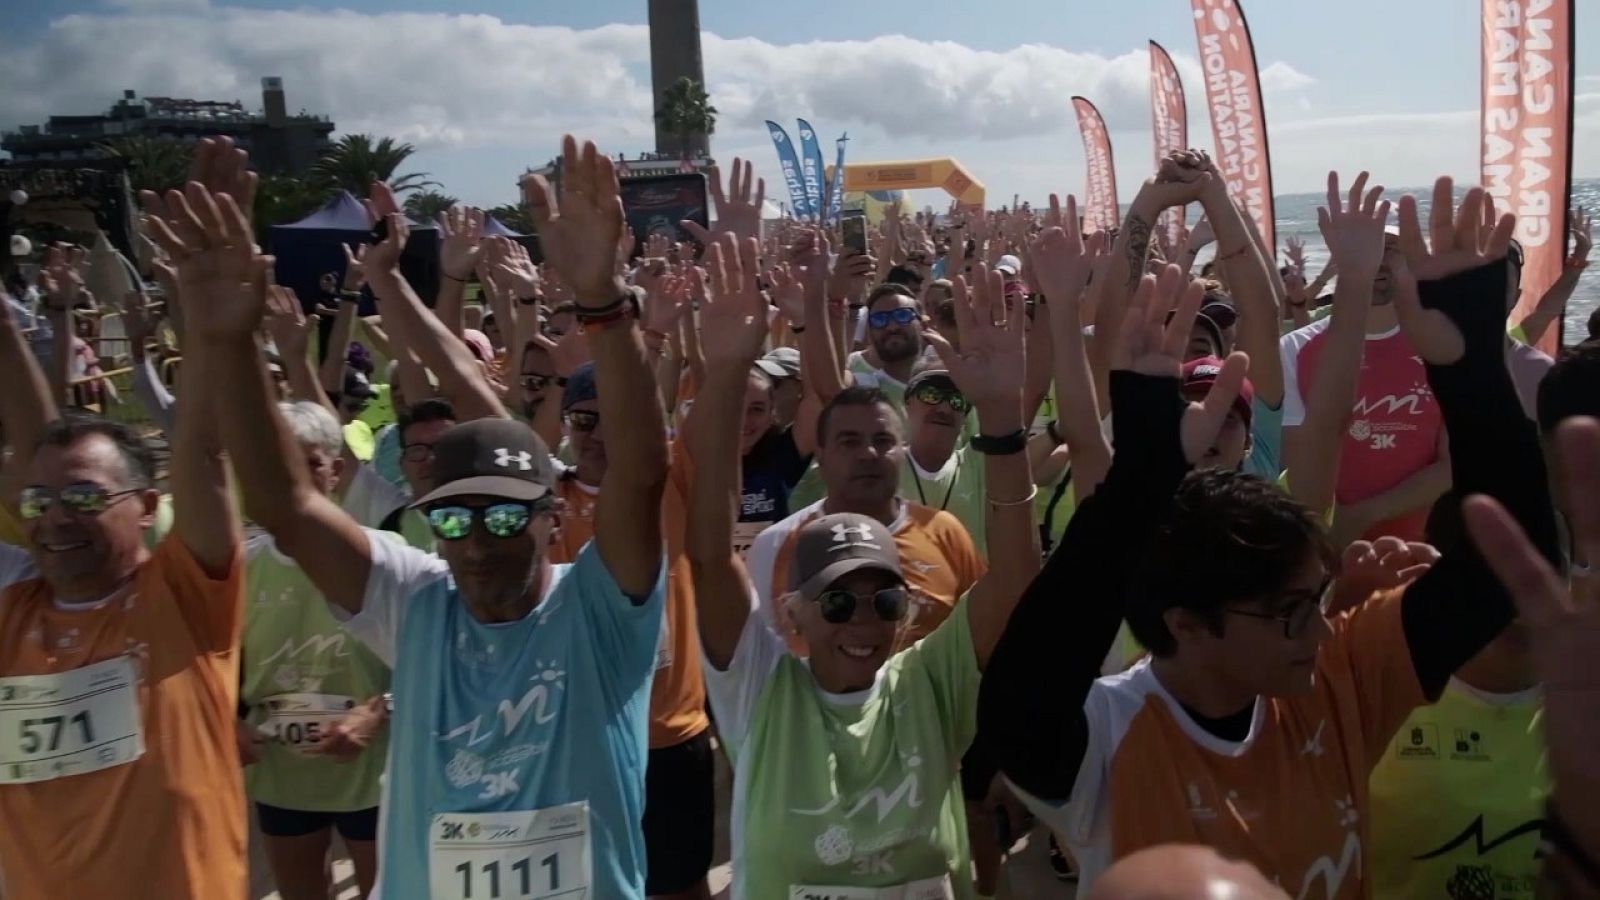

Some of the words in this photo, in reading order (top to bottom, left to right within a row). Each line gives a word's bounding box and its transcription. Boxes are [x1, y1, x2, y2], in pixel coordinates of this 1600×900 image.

[1369, 433, 1396, 449] 3K
[18, 709, 96, 754] 571
[477, 768, 520, 799] 3K
[440, 821, 464, 840] 3K
[455, 852, 560, 899] 1111
[851, 850, 895, 875] 3K
